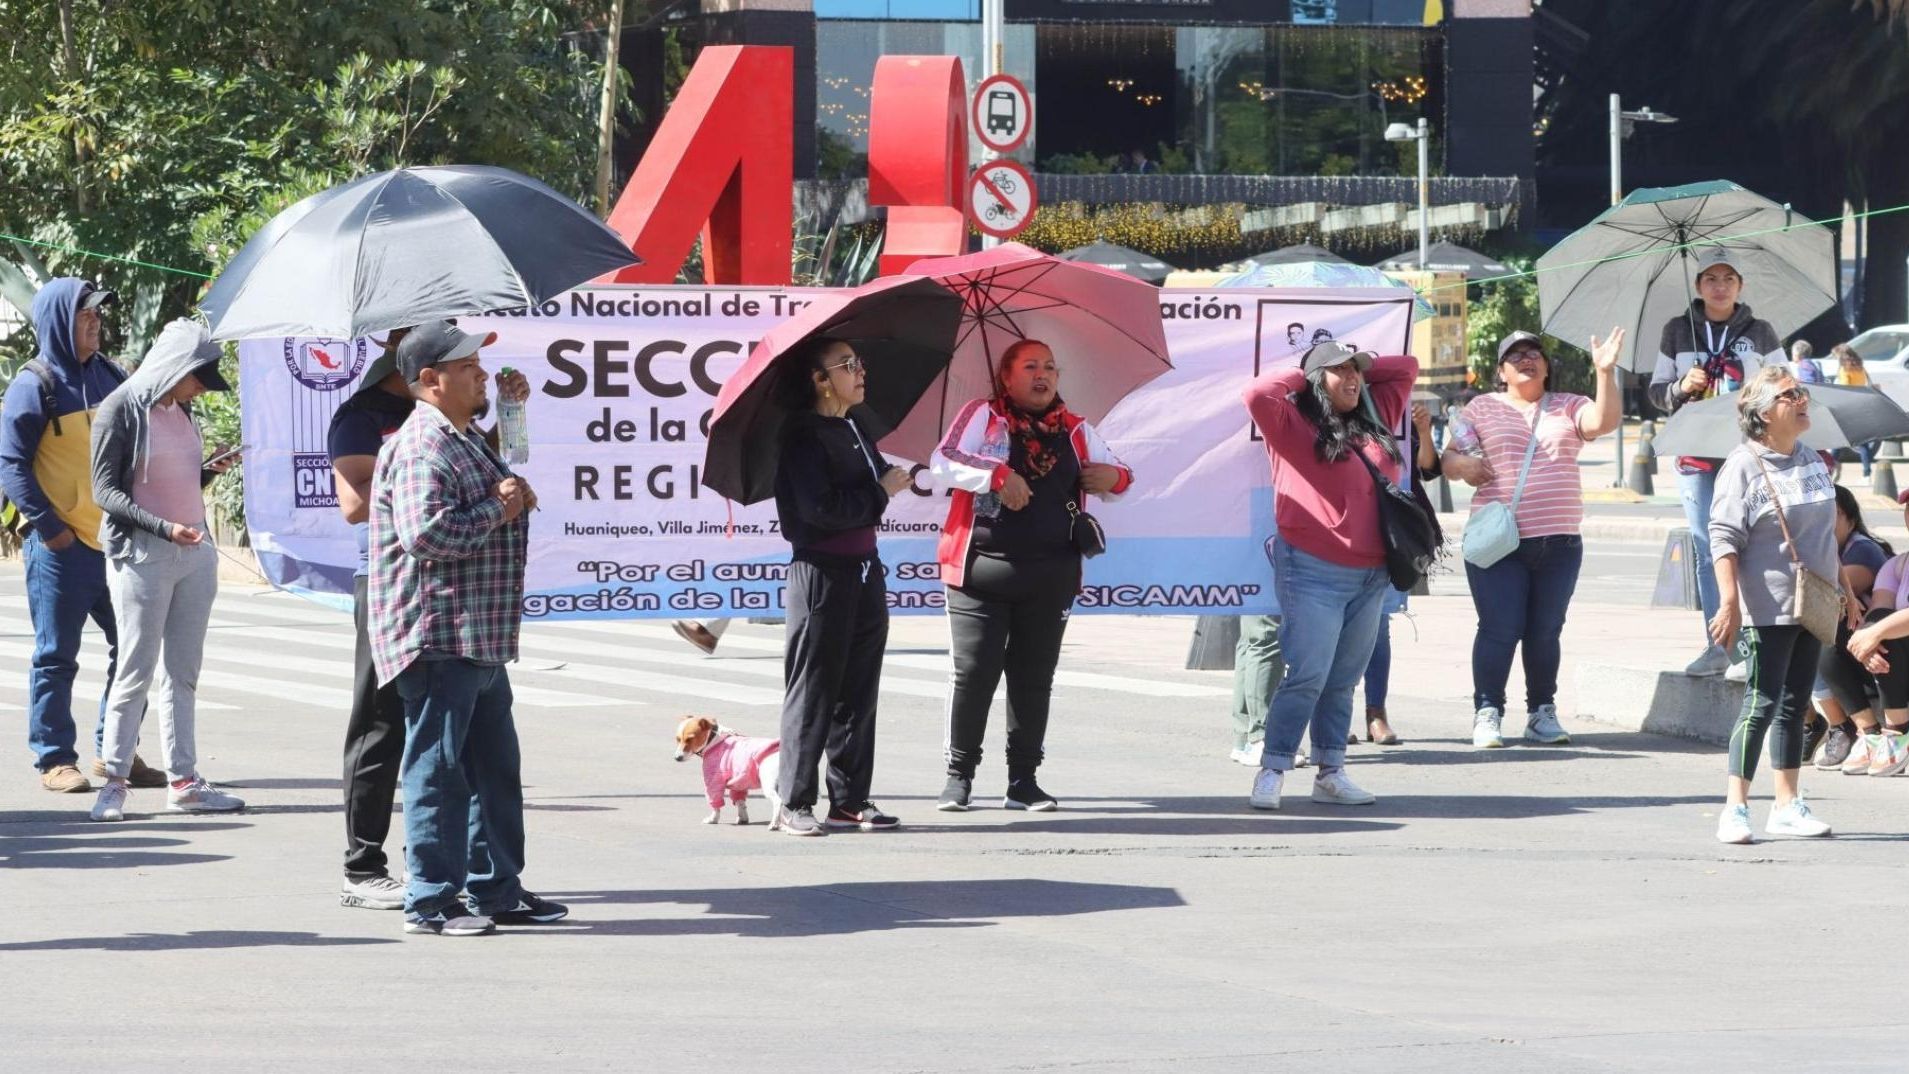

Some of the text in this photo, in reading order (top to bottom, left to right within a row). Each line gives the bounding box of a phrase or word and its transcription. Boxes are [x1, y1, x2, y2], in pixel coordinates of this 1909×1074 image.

[571, 292, 711, 317] Nacional
[721, 293, 760, 317] de
[1159, 296, 1242, 320] ación
[542, 339, 763, 398] SECC
[586, 406, 638, 443] de
[651, 406, 686, 443] la
[296, 457, 332, 467] SECCIÓ
[297, 468, 333, 496] CN
[574, 464, 699, 500] REGI
[300, 497, 340, 506] MICHOA
[565, 522, 653, 538] Huaniqueo,
[658, 521, 693, 534] Villa
[666, 560, 705, 582] el
[521, 587, 660, 617] gación
[668, 587, 723, 610] de
[731, 587, 769, 610] la
[1077, 584, 1261, 607] SICAMM”
